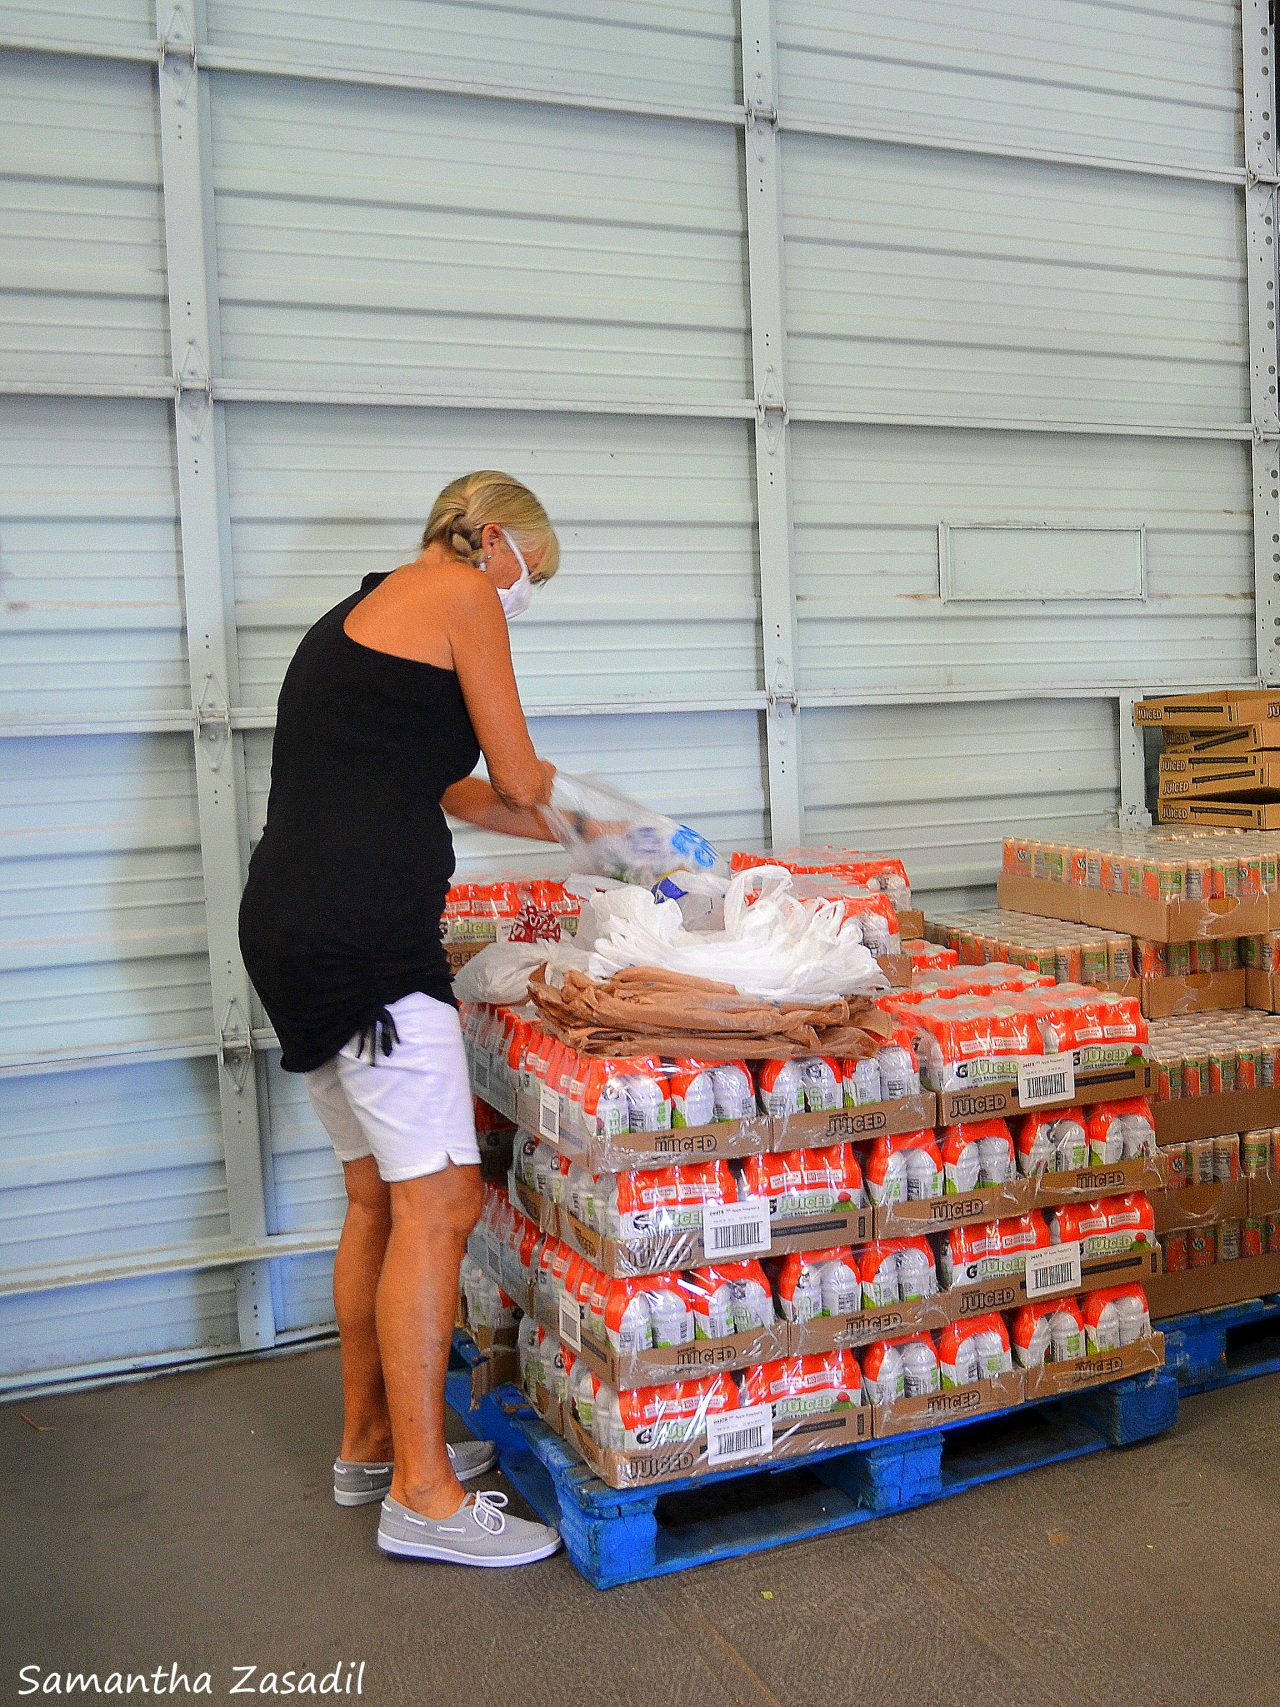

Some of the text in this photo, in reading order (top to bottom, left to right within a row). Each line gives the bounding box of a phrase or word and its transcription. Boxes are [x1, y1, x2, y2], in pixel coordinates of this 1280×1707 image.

[1138, 707, 1162, 720] JUICED
[1166, 730, 1189, 745] JUICED
[1161, 759, 1186, 772] JUICED
[1163, 781, 1189, 794] JUICED
[1162, 806, 1188, 820] JUICED
[1081, 1048, 1128, 1064] JUICED
[950, 1094, 1006, 1118] JUICED
[826, 1111, 886, 1136] JUICED
[1172, 1157, 1184, 1172] V8
[779, 1195, 835, 1214] JUICED
[930, 1198, 984, 1223] JUICED
[1088, 1236, 1134, 1250] JUICED
[966, 1264, 978, 1278] G
[959, 1286, 1016, 1314] JUICED
[845, 1312, 904, 1336] JUICED
[1074, 1357, 1124, 1380] JUICED
